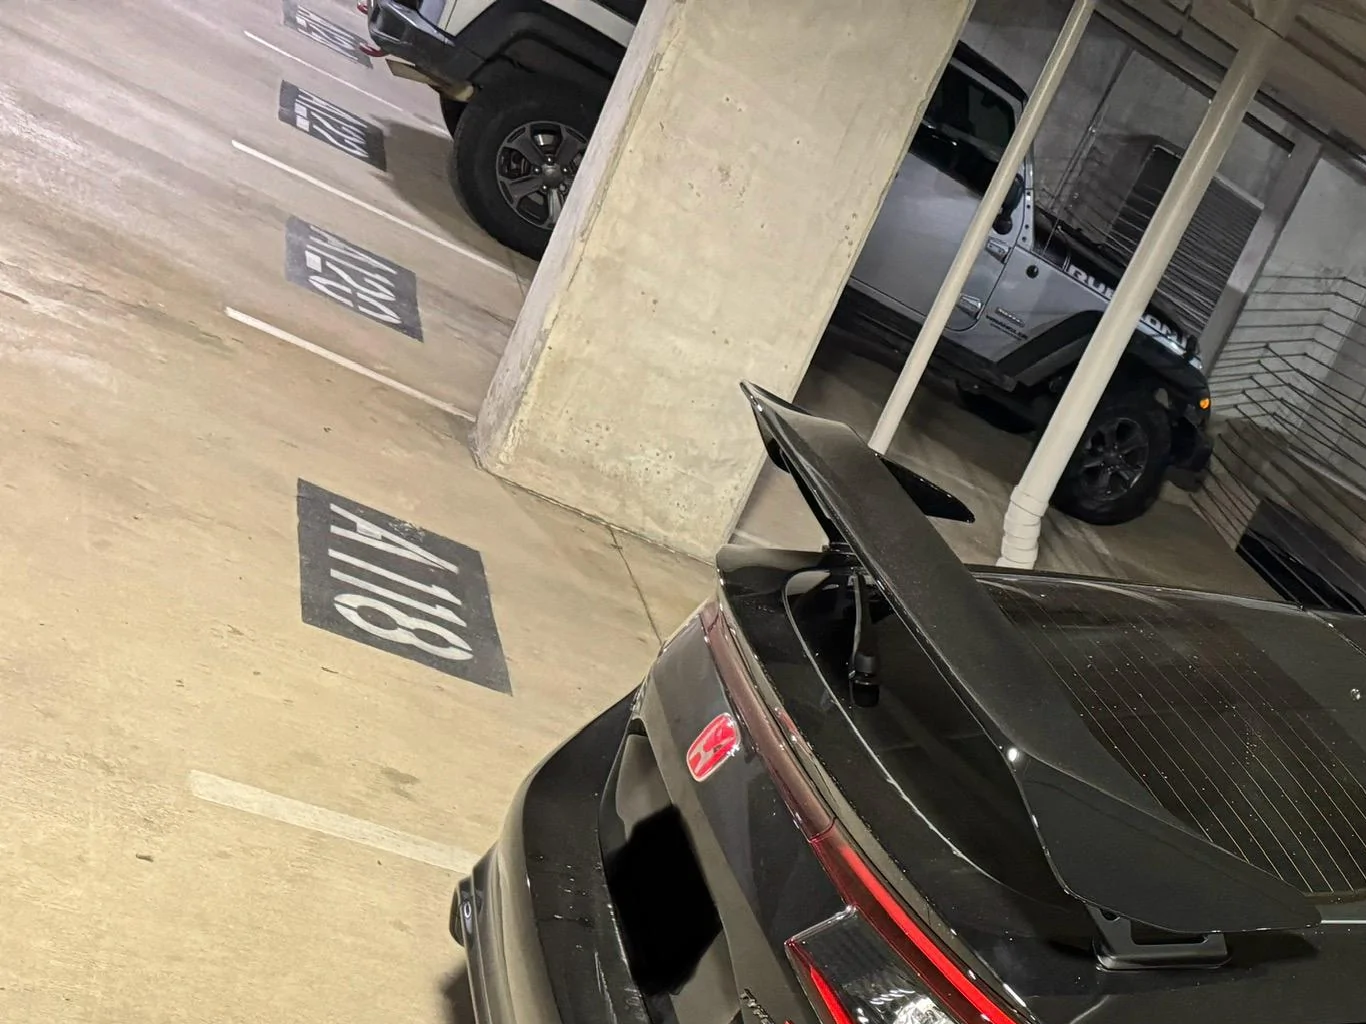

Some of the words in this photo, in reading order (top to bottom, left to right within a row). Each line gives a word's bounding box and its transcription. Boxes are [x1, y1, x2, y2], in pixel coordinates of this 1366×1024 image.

[294, 88, 369, 158] A122
[305, 225, 402, 324] A120
[1068, 264, 1188, 345] RUON
[328, 503, 474, 660] A118
